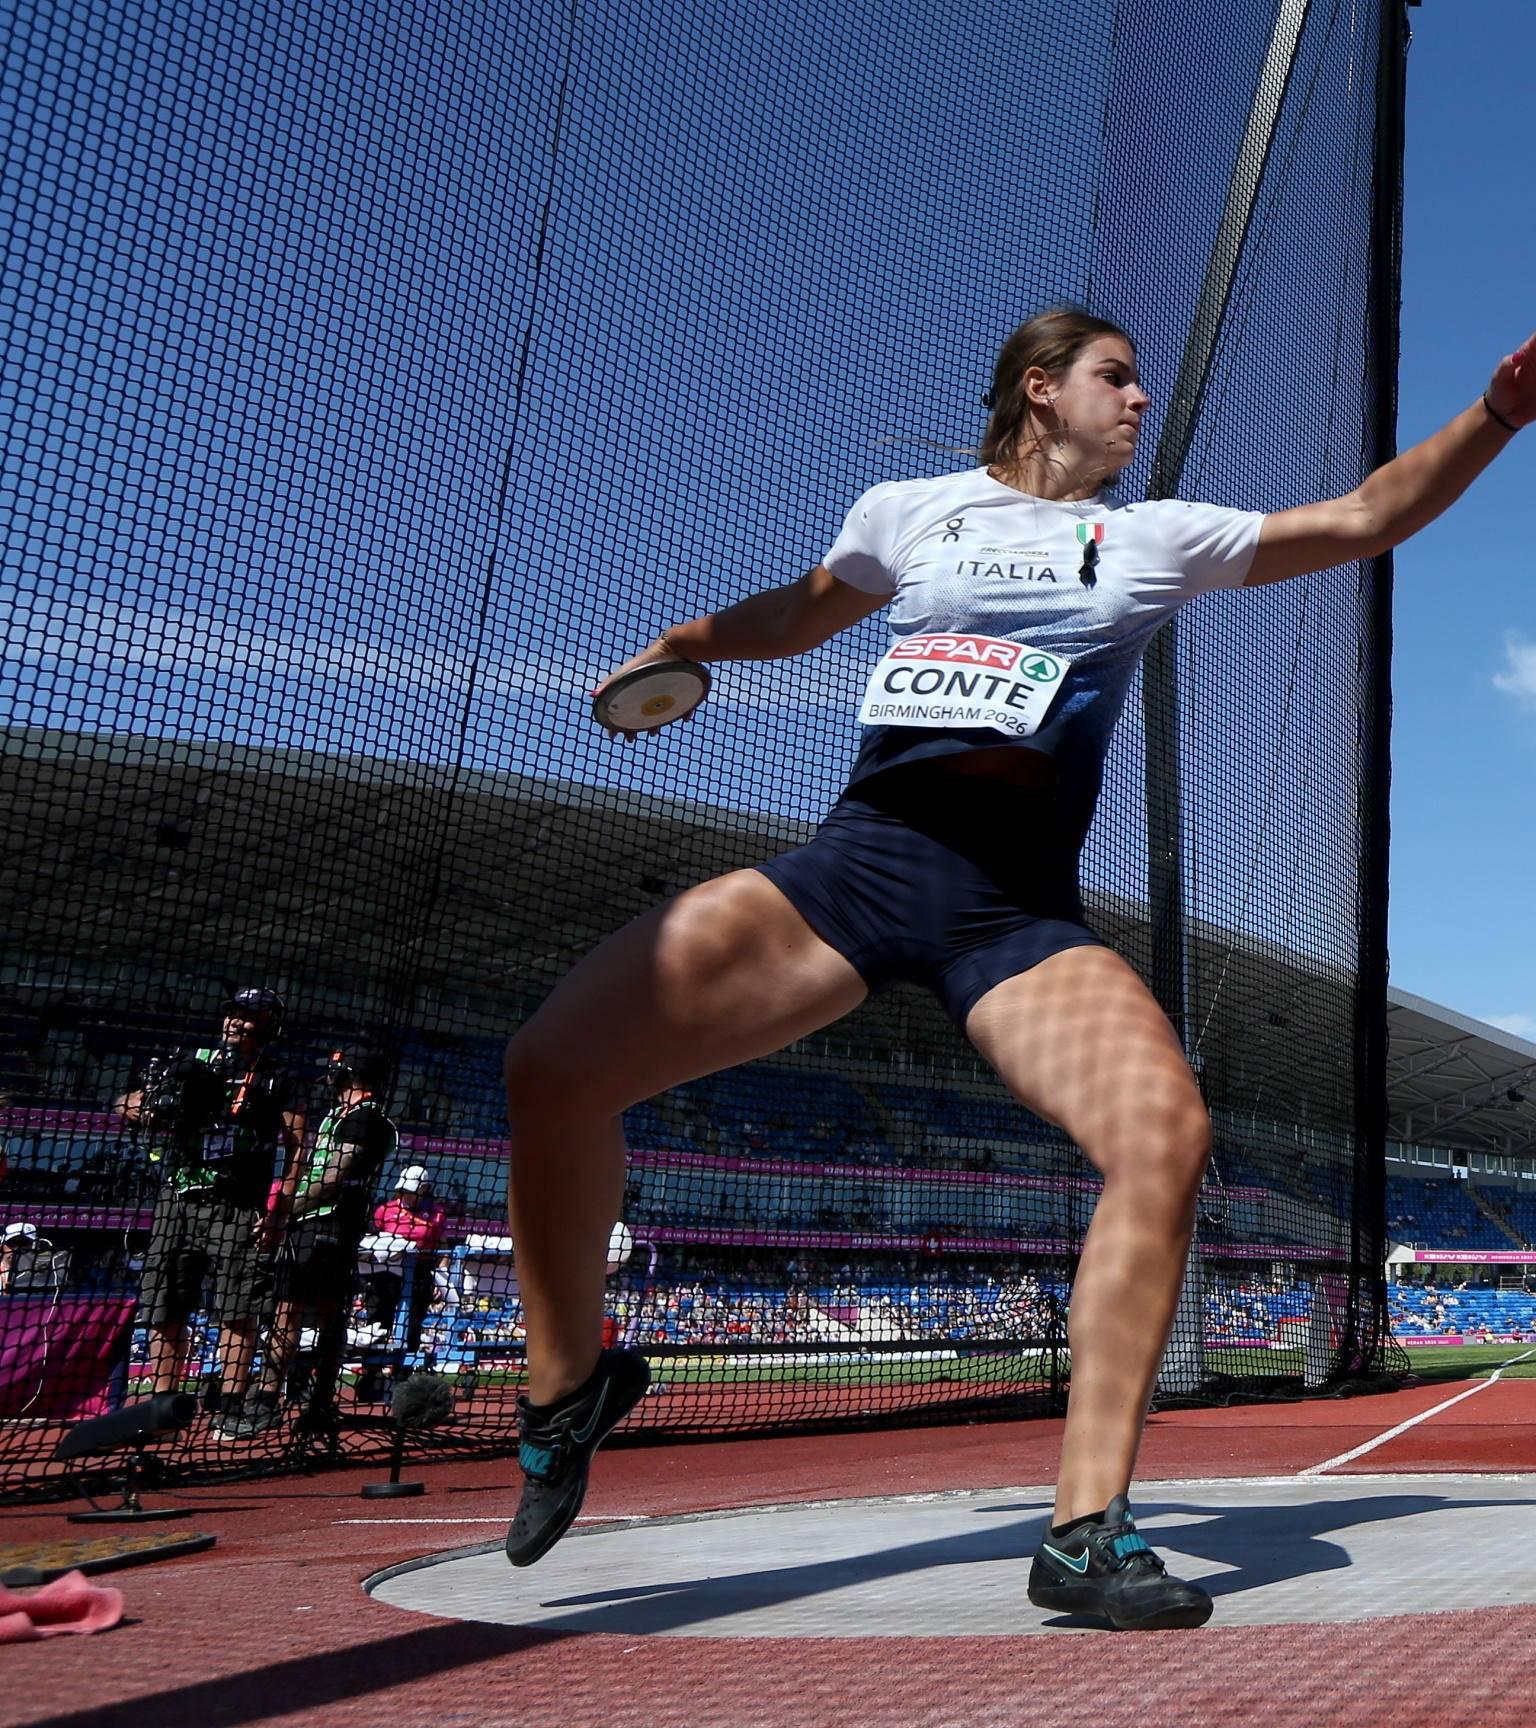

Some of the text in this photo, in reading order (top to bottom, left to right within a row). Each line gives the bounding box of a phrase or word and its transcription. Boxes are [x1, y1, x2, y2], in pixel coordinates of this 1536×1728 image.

[956, 560, 1057, 583] ITALIA
[895, 638, 1017, 667] SPAR
[884, 667, 1035, 710] CONTE
[869, 703, 1028, 735] BIRMINGHAM 2026
